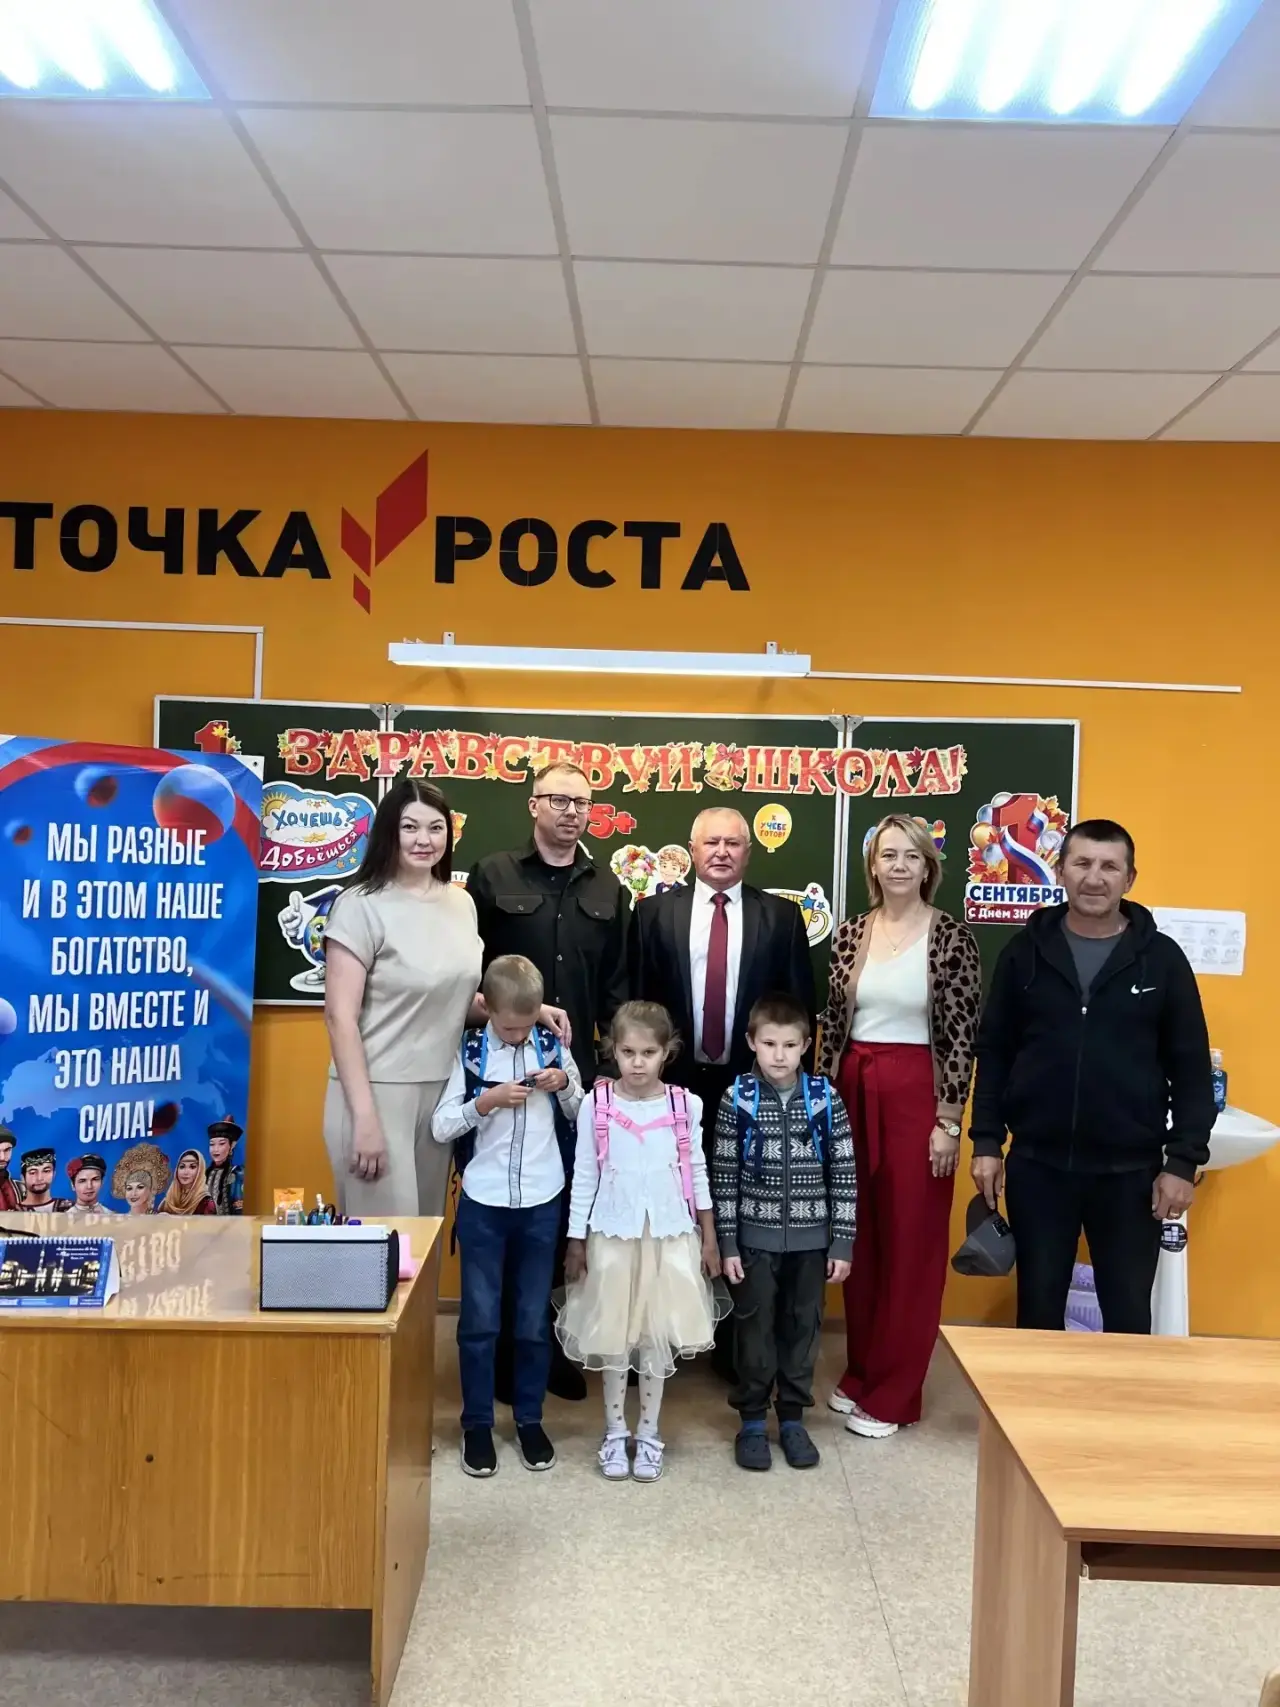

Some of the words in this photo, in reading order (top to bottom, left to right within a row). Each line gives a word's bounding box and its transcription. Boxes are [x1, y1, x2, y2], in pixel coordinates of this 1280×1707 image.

[0, 502, 331, 579] ТОЧКА
[434, 516, 750, 591] РОСТА
[742, 744, 962, 797] ШКОЛА!
[587, 804, 637, 839] 5+
[760, 822, 787, 831] УЧЕБЕ
[760, 829, 786, 838] ГОТОВ!
[47, 822, 98, 862] МЫ
[107, 825, 207, 866] РАЗНЫЕ
[22, 879, 41, 919] И
[51, 880, 67, 919] В
[76, 880, 147, 919] ЭТОМ
[156, 882, 224, 919] НАШЕ
[969, 885, 1064, 904] СЕНТЯБРЯ
[51, 936, 194, 977] БОГАТСТВО,
[28, 993, 80, 1034] МЫ
[89, 990, 186, 1031] ВМЕСТЕ
[193, 989, 209, 1026] И
[54, 1048, 101, 1089] ЭТО
[111, 1044, 181, 1085] НАША
[78, 1100, 155, 1143] СИЛА!
